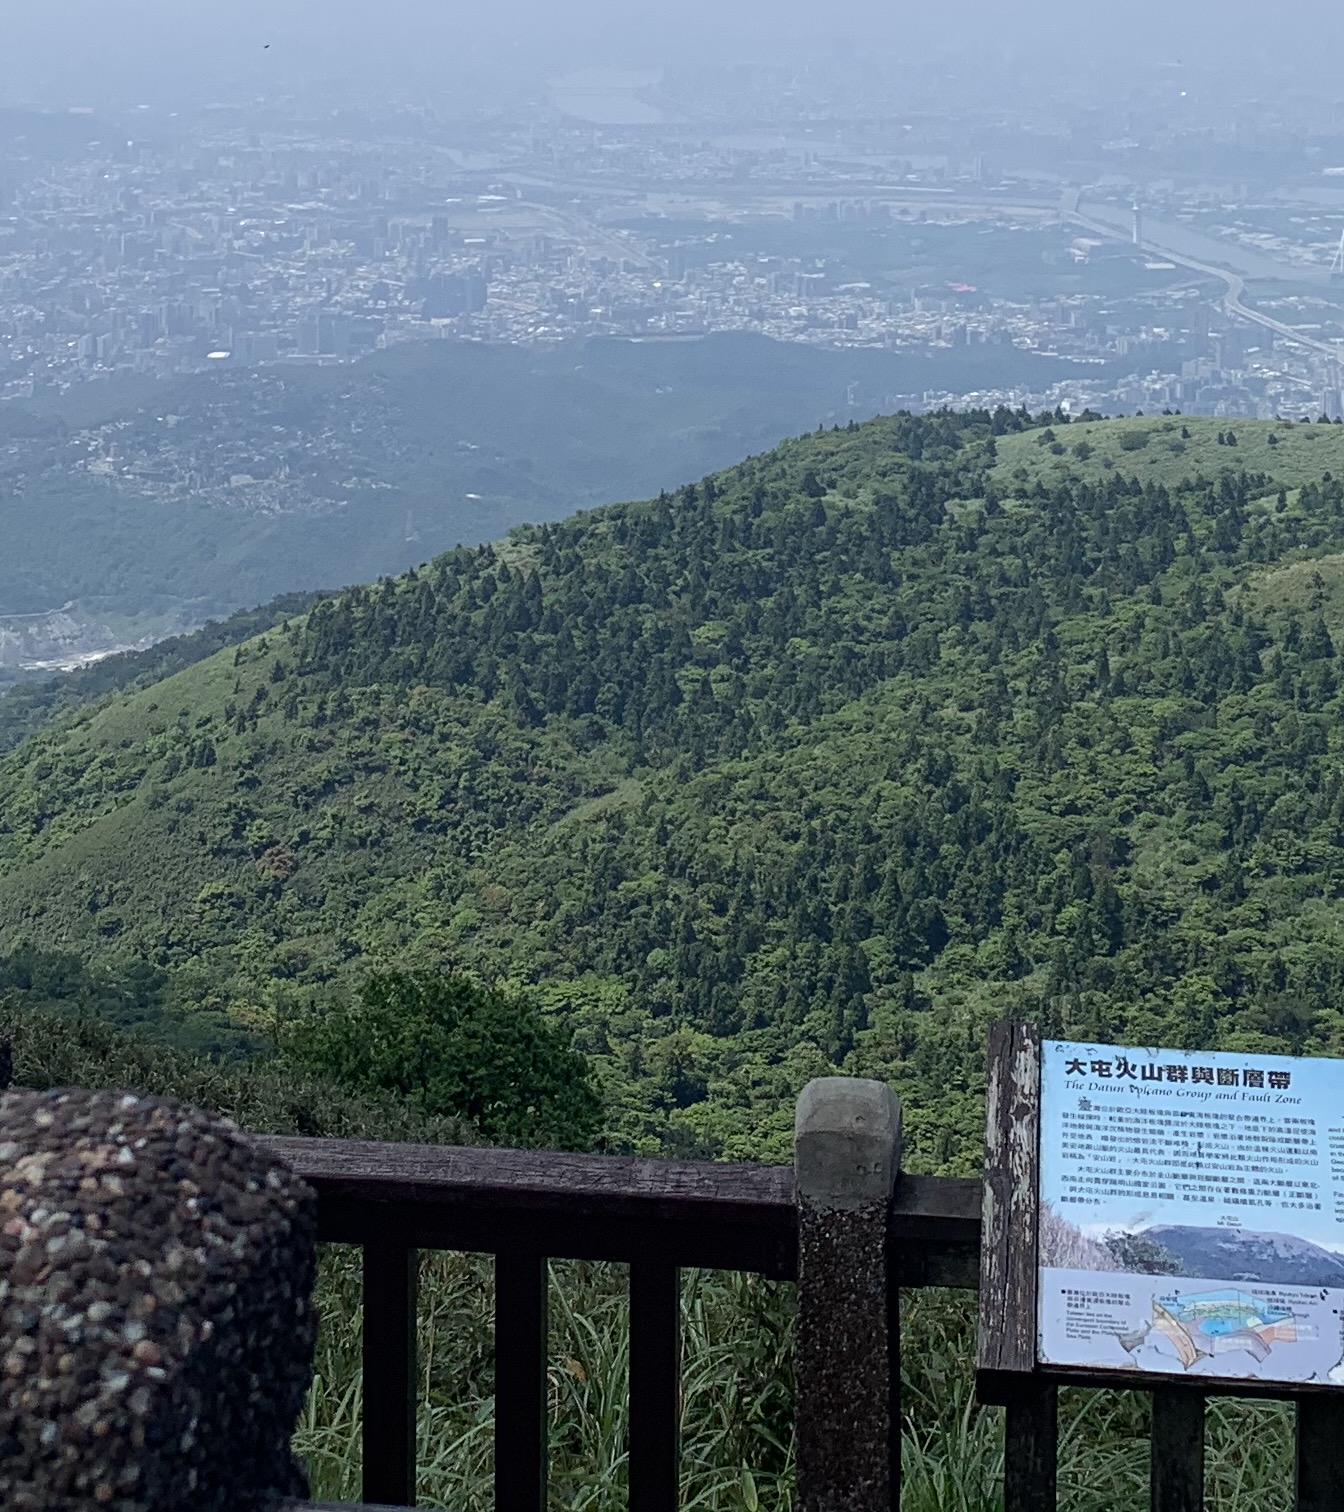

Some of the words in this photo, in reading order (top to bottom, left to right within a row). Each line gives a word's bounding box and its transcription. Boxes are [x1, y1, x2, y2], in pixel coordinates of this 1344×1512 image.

[1064, 1057, 1292, 1090] 大屯火山群與斷層帶
[1064, 1078, 1084, 1090] The
[1088, 1081, 1125, 1093] Datun
[1175, 1086, 1212, 1102] Group
[1214, 1088, 1240, 1101] and
[1240, 1090, 1271, 1103] Fault
[1274, 1093, 1303, 1105] Zone
